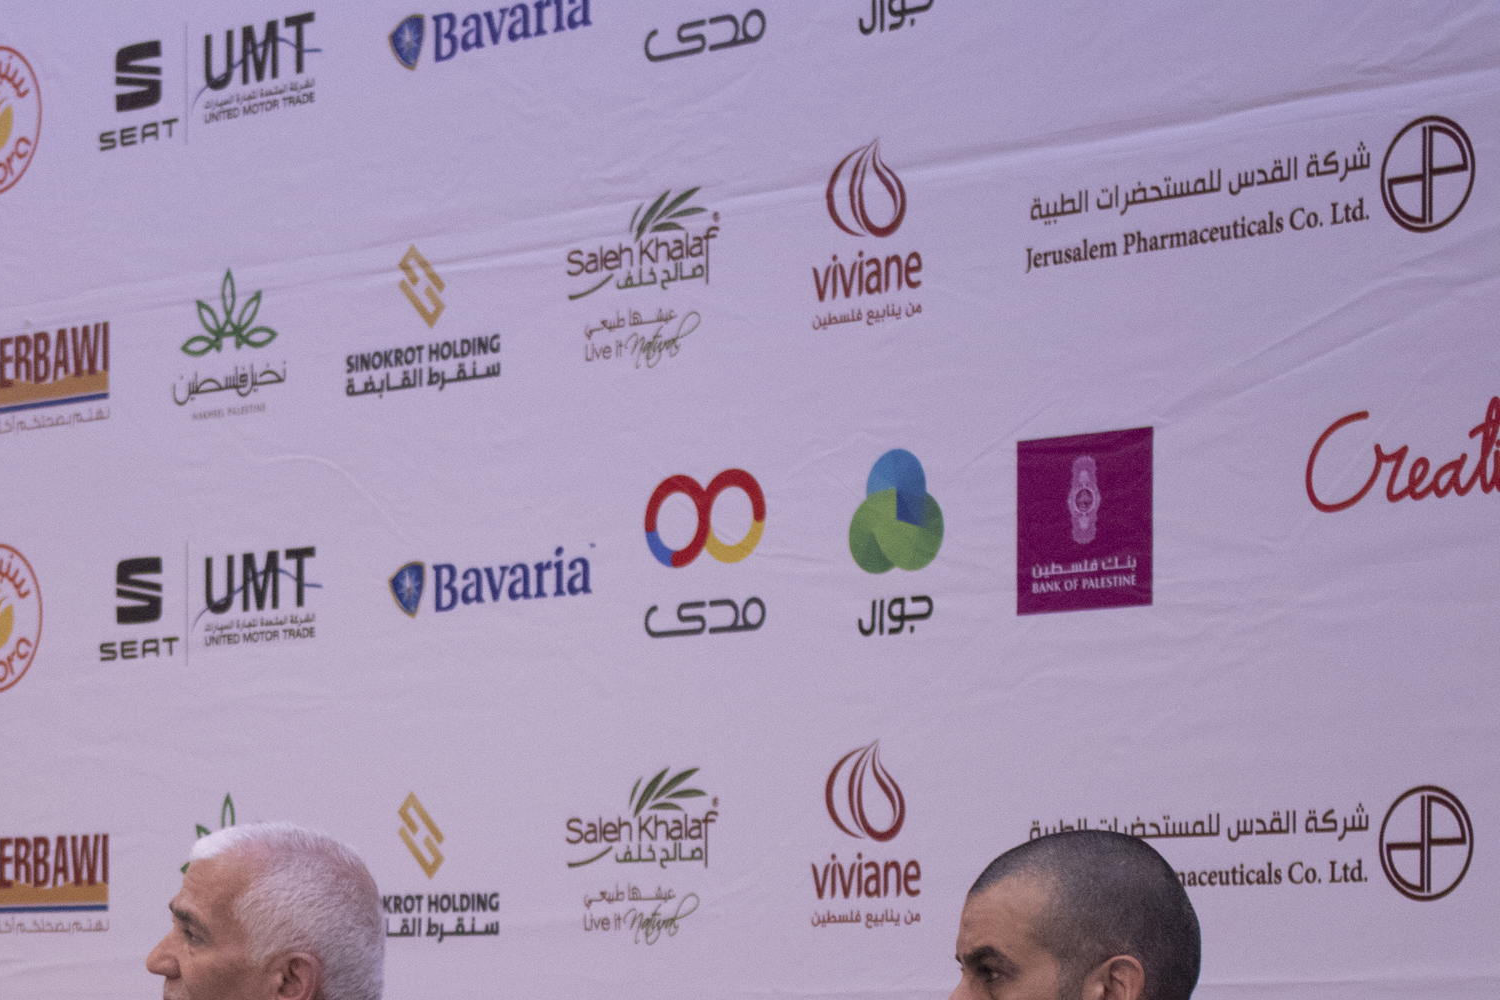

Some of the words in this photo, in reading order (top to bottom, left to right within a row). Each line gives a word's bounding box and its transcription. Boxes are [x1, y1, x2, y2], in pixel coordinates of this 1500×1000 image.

[432, 0, 593, 63] Bavaria
[204, 12, 316, 90] UMT
[204, 107, 240, 124] UNITED
[242, 99, 279, 116] MOTOR
[282, 91, 316, 107] TRADE
[100, 118, 179, 151] SEAT
[1228, 155, 1298, 196] القدس
[1306, 141, 1371, 183] شركة
[1030, 189, 1089, 226] الطبية
[1096, 168, 1222, 217] للمستحضرات
[1026, 237, 1118, 273] Jerusalem
[1123, 211, 1284, 256] Pharmaceuticals
[1289, 207, 1324, 231] Co.
[1330, 197, 1371, 225] Ltd.
[567, 243, 634, 277] Saleh
[639, 226, 720, 285] Khalaf
[616, 267, 657, 290] خلف
[661, 262, 704, 290] صالح
[812, 250, 923, 303] viviane
[812, 308, 863, 331] فلسطين
[905, 302, 923, 318] من
[346, 345, 424, 374] SINOKROT
[428, 333, 501, 362] HOLDING
[585, 343, 613, 362] Live
[346, 367, 423, 399] القابضة
[427, 360, 501, 391] سنقرط
[1031, 558, 1099, 580] فلسطين
[1101, 554, 1138, 572] بنك
[204, 546, 316, 615] UMT
[433, 545, 593, 613] Bavaria
[1031, 580, 1061, 595] BANK
[1064, 578, 1080, 592] OF
[1082, 574, 1138, 590] PALESTINE
[859, 595, 935, 637] جوال
[100, 636, 180, 662] SEAT
[204, 633, 240, 647] UNITED
[242, 629, 280, 643] MOTOR
[282, 625, 316, 640] TRADE
[1227, 809, 1297, 843] القدس
[1305, 803, 1369, 842] شركة
[566, 816, 633, 844] Saleh
[638, 809, 719, 868] Khalaf
[615, 843, 657, 864] خلف
[660, 841, 704, 869] صالح
[811, 852, 922, 900] viviane
[1288, 861, 1322, 885] Co.
[1329, 858, 1369, 884] Ltd.
[382, 893, 424, 914] KROT
[427, 891, 500, 914] HOLDING
[904, 909, 921, 926] من
[385, 916, 423, 938] القا
[426, 916, 500, 943] سنقرط
[584, 912, 612, 931] Live
[811, 909, 862, 928] فلسطين
